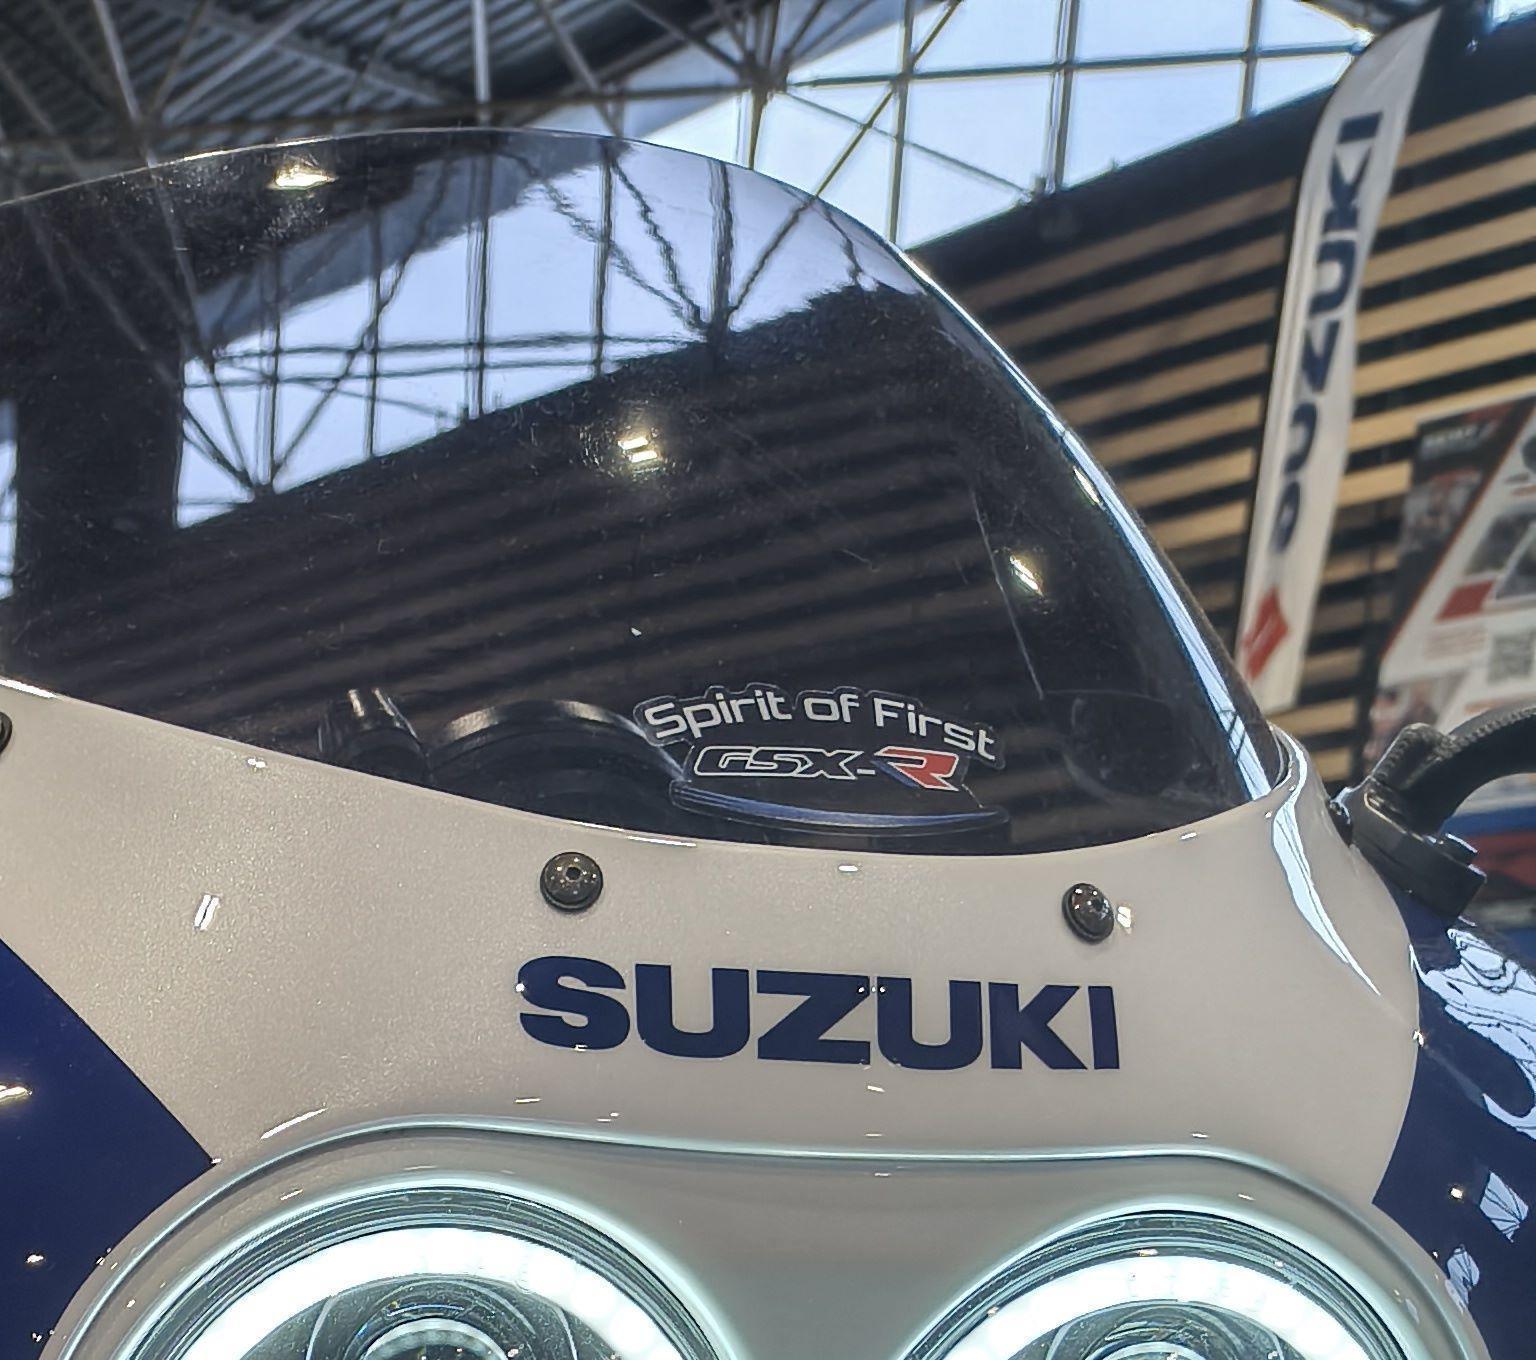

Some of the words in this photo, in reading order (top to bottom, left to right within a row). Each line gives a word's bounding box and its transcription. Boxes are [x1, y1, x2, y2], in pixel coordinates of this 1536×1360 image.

[1274, 111, 1383, 555] SUZUKI
[644, 689, 793, 739] Spirit
[803, 692, 860, 723] of
[873, 696, 996, 761] First
[693, 744, 960, 792] GSX-R
[517, 955, 1120, 1071] SUZUKI
